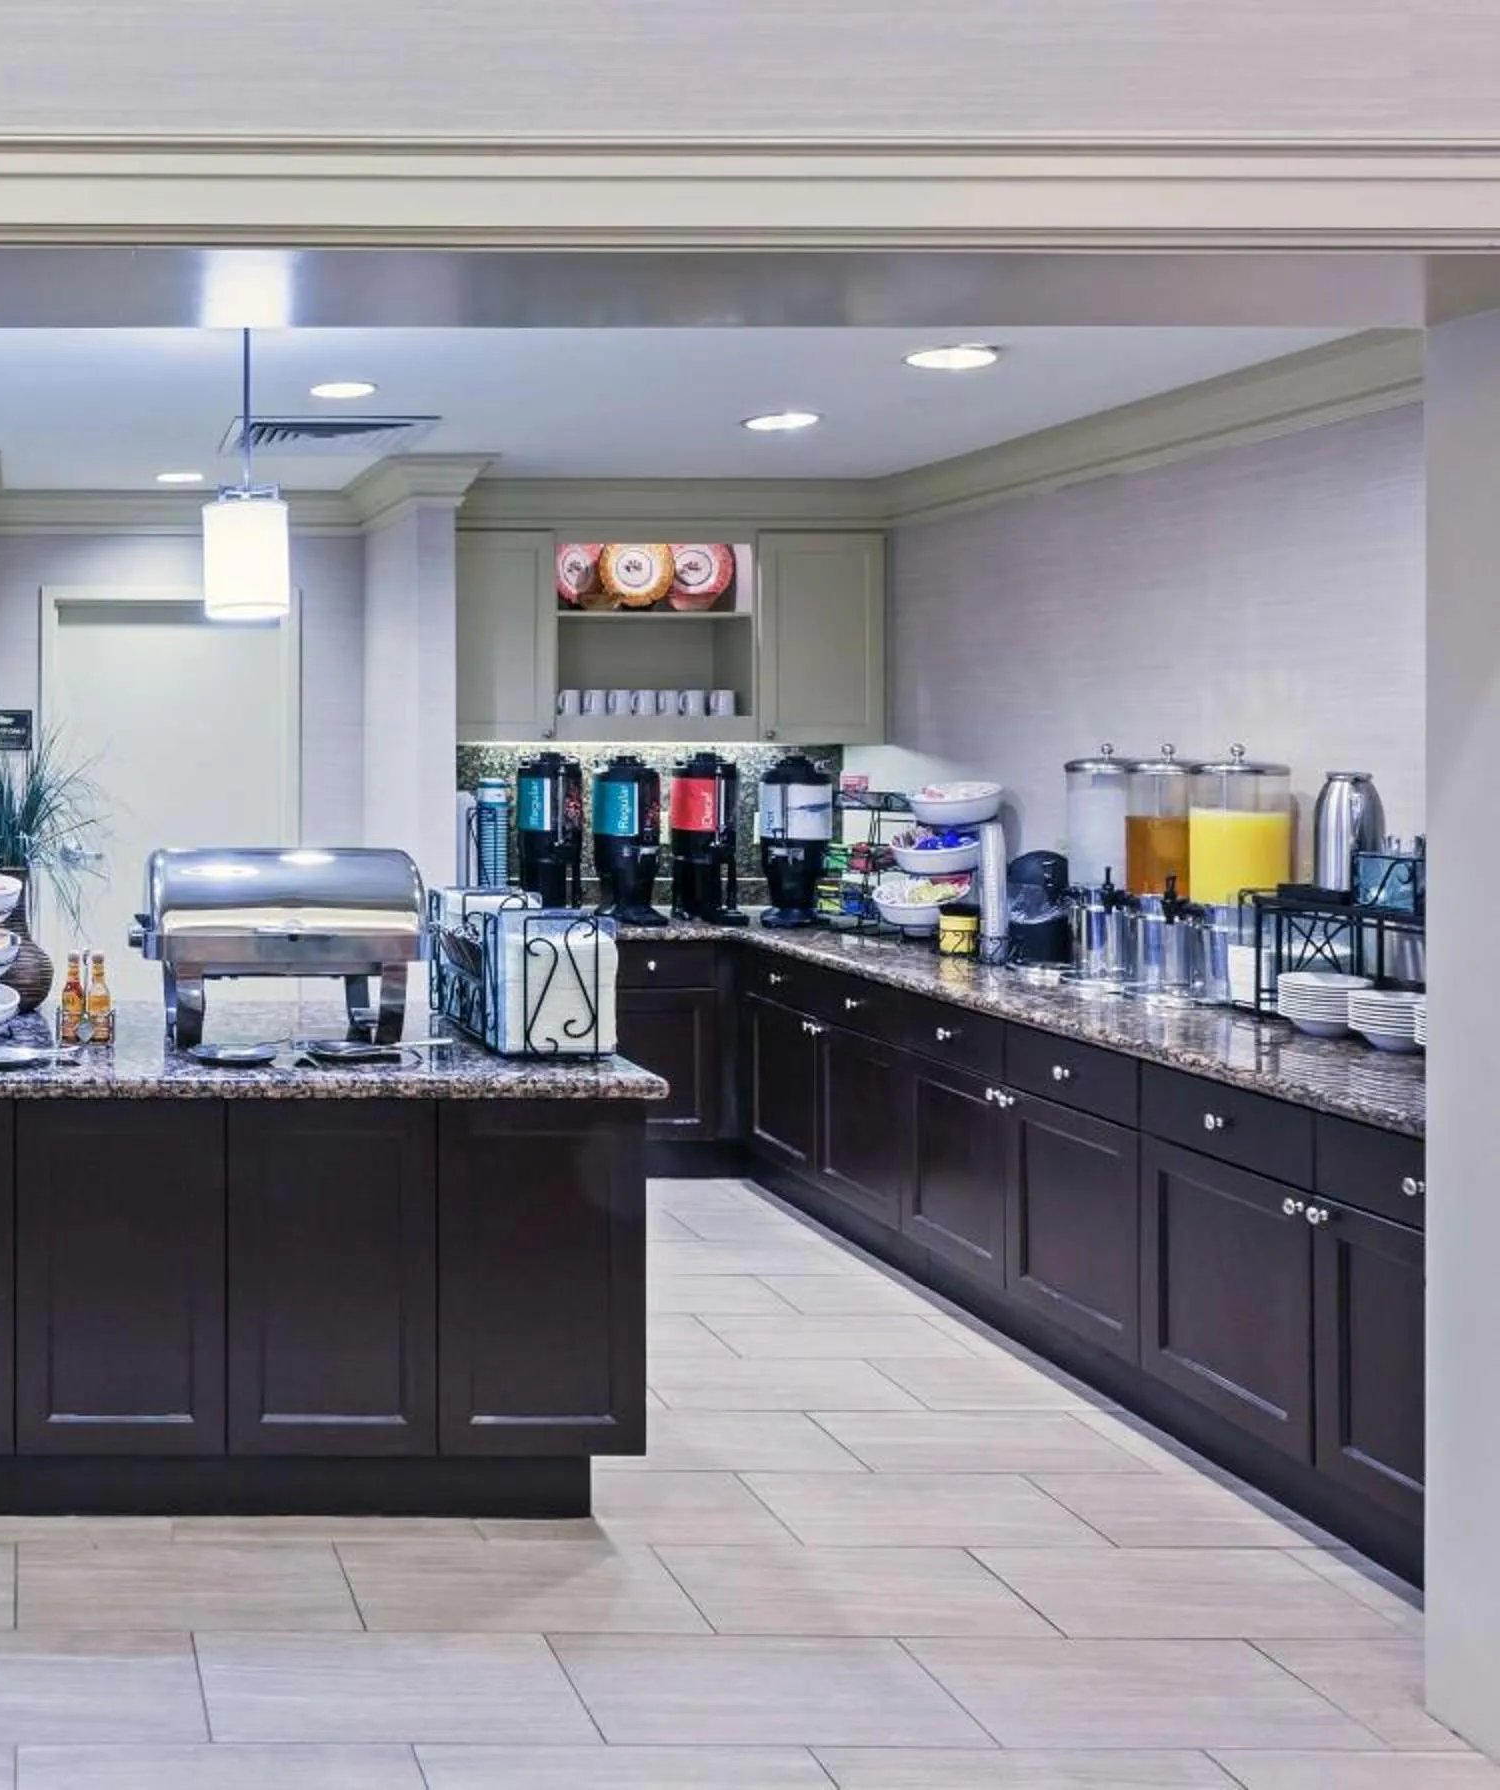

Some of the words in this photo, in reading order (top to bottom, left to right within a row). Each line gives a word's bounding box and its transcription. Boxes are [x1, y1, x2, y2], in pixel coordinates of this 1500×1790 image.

[529, 780, 541, 827] Regular
[617, 784, 631, 829] Regular
[701, 791, 712, 828] Decaf
